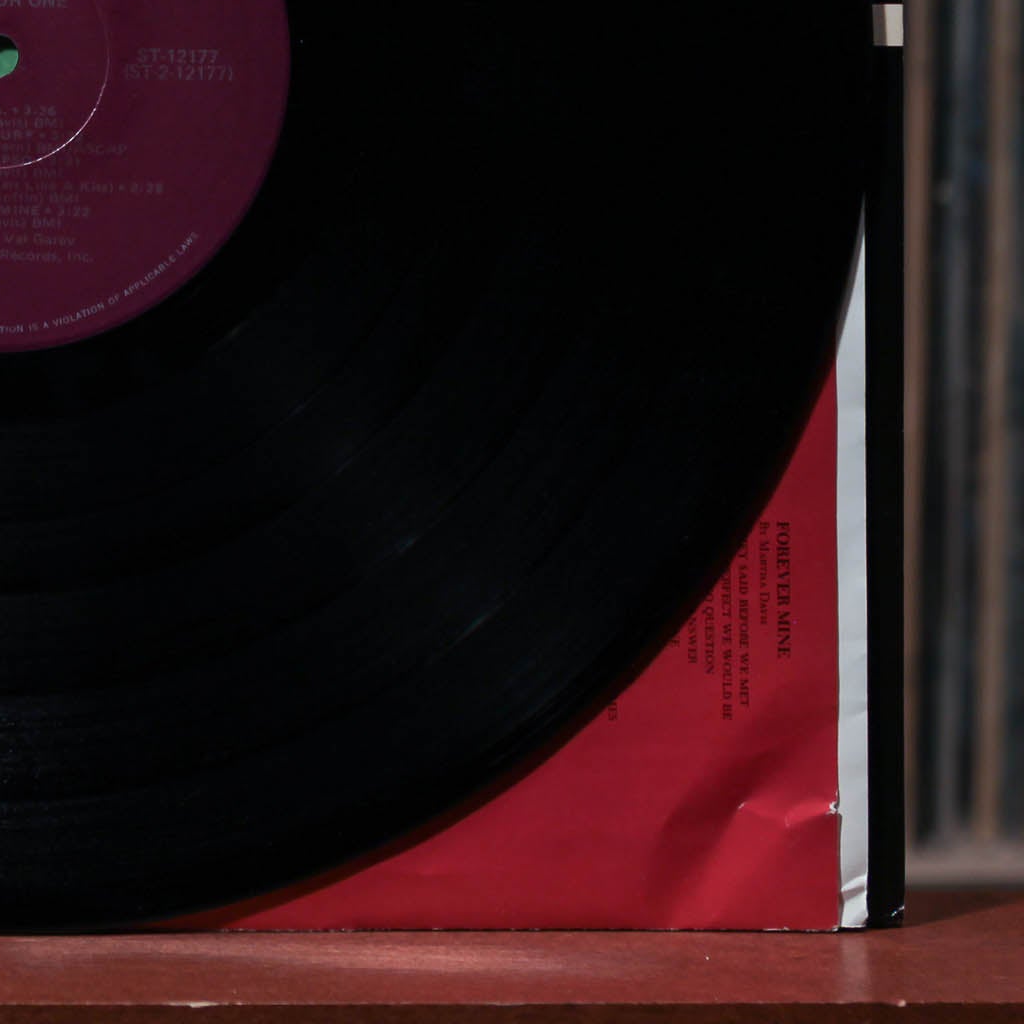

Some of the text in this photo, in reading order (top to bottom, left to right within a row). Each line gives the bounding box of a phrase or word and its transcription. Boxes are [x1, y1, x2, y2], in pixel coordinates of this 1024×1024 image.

[53, 303, 105, 327] VIOLATION
[108, 295, 120, 304] OF
[739, 565, 749, 706] SAID BEFORE WE MET
[776, 522, 790, 657] FOREVER MINE
